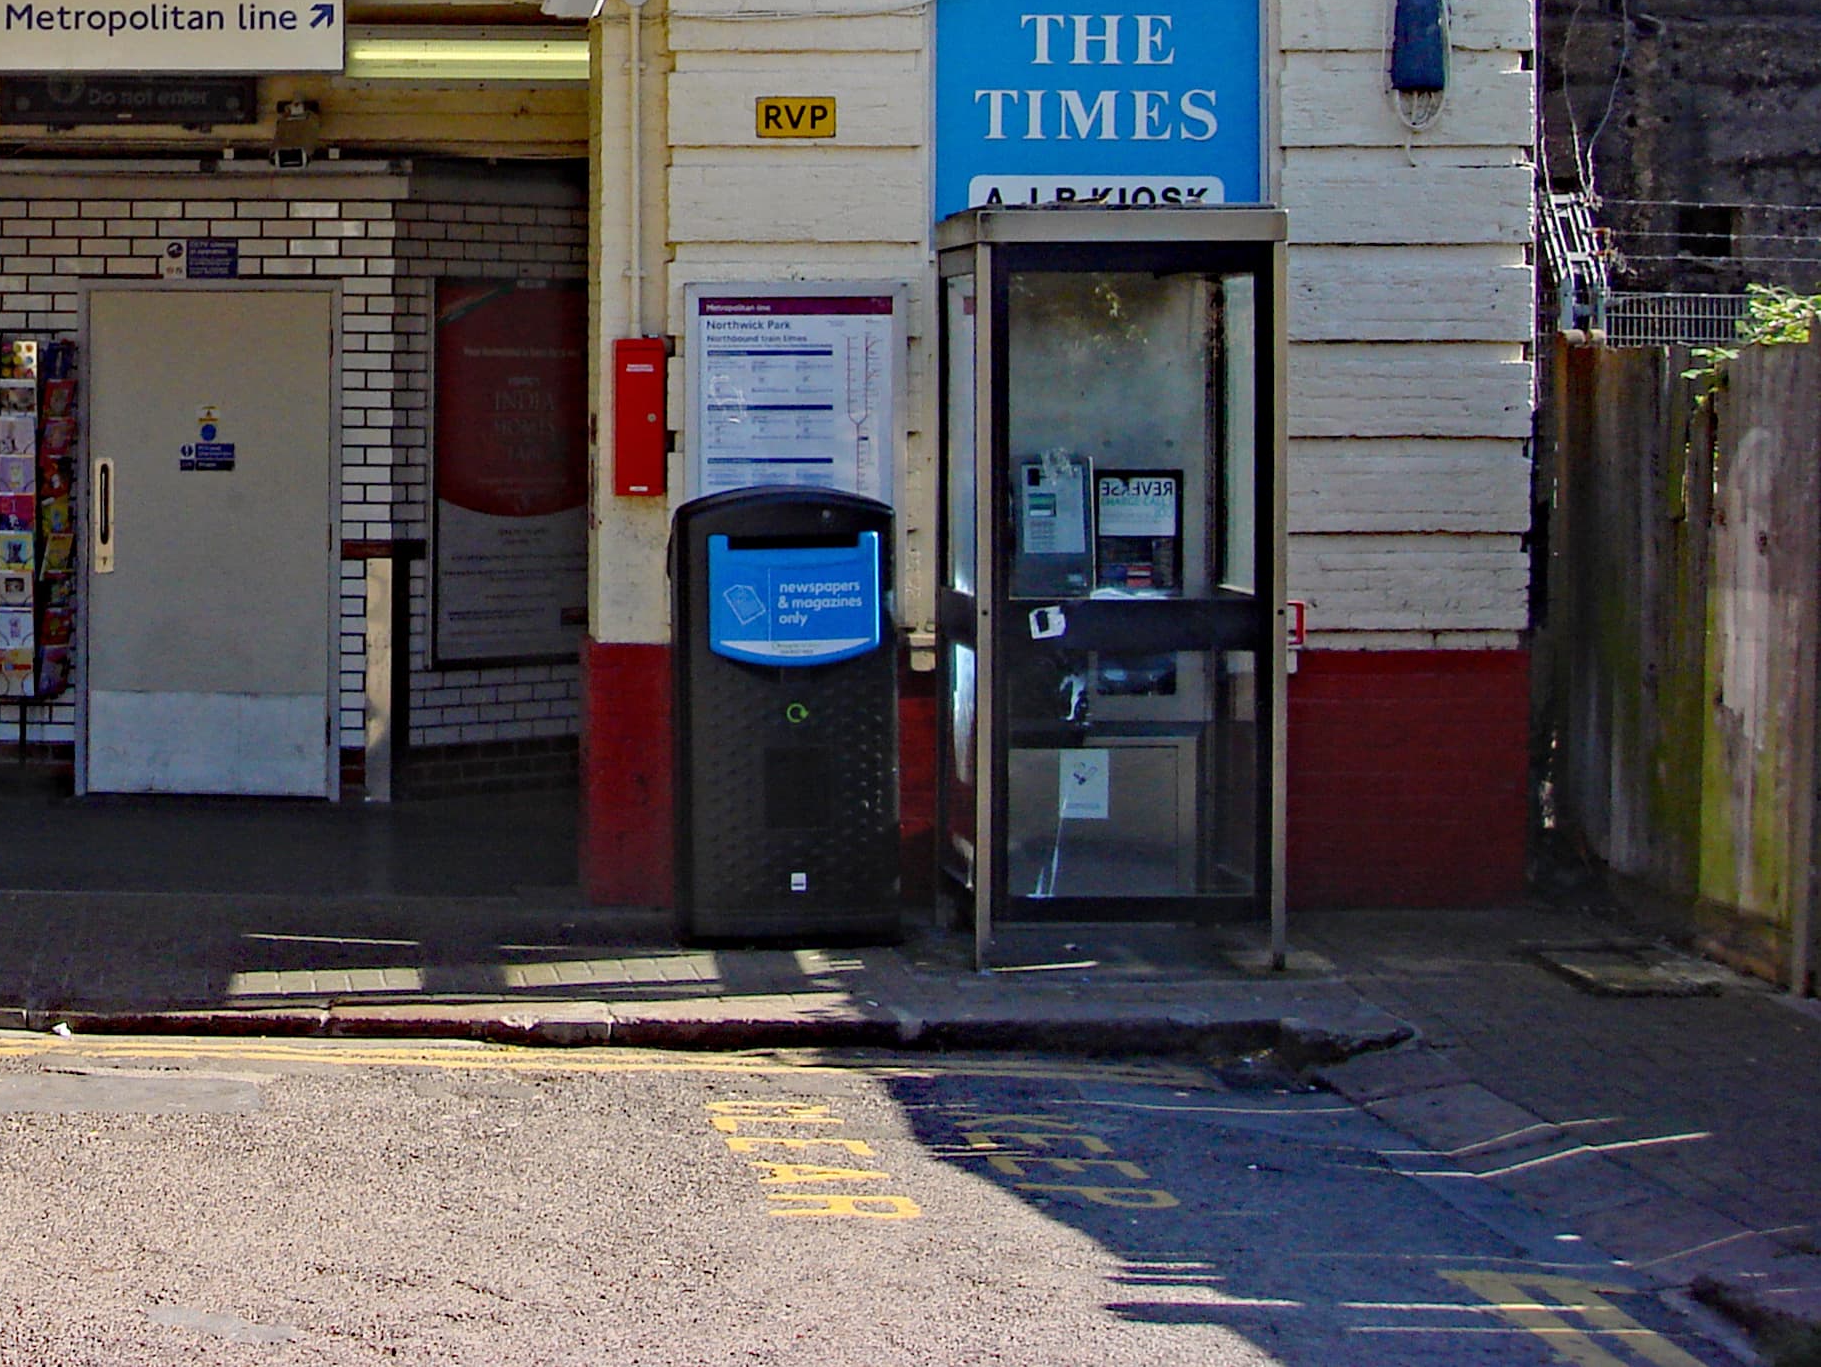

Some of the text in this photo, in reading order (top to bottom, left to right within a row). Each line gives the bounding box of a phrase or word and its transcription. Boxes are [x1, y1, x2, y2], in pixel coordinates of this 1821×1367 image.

[5, 3, 298, 36] Metropolitan line
[1021, 14, 1176, 66] THE
[763, 104, 829, 130] RVP
[974, 89, 1219, 141] TIMES
[706, 320, 791, 330] Northwick Park
[707, 335, 759, 344] Northbound
[779, 581, 861, 596] newspapers
[777, 594, 863, 611] & magazines
[779, 612, 809, 627] only
[704, 1100, 923, 1220] CLEAR
[940, 1112, 1180, 1209] KEEP
